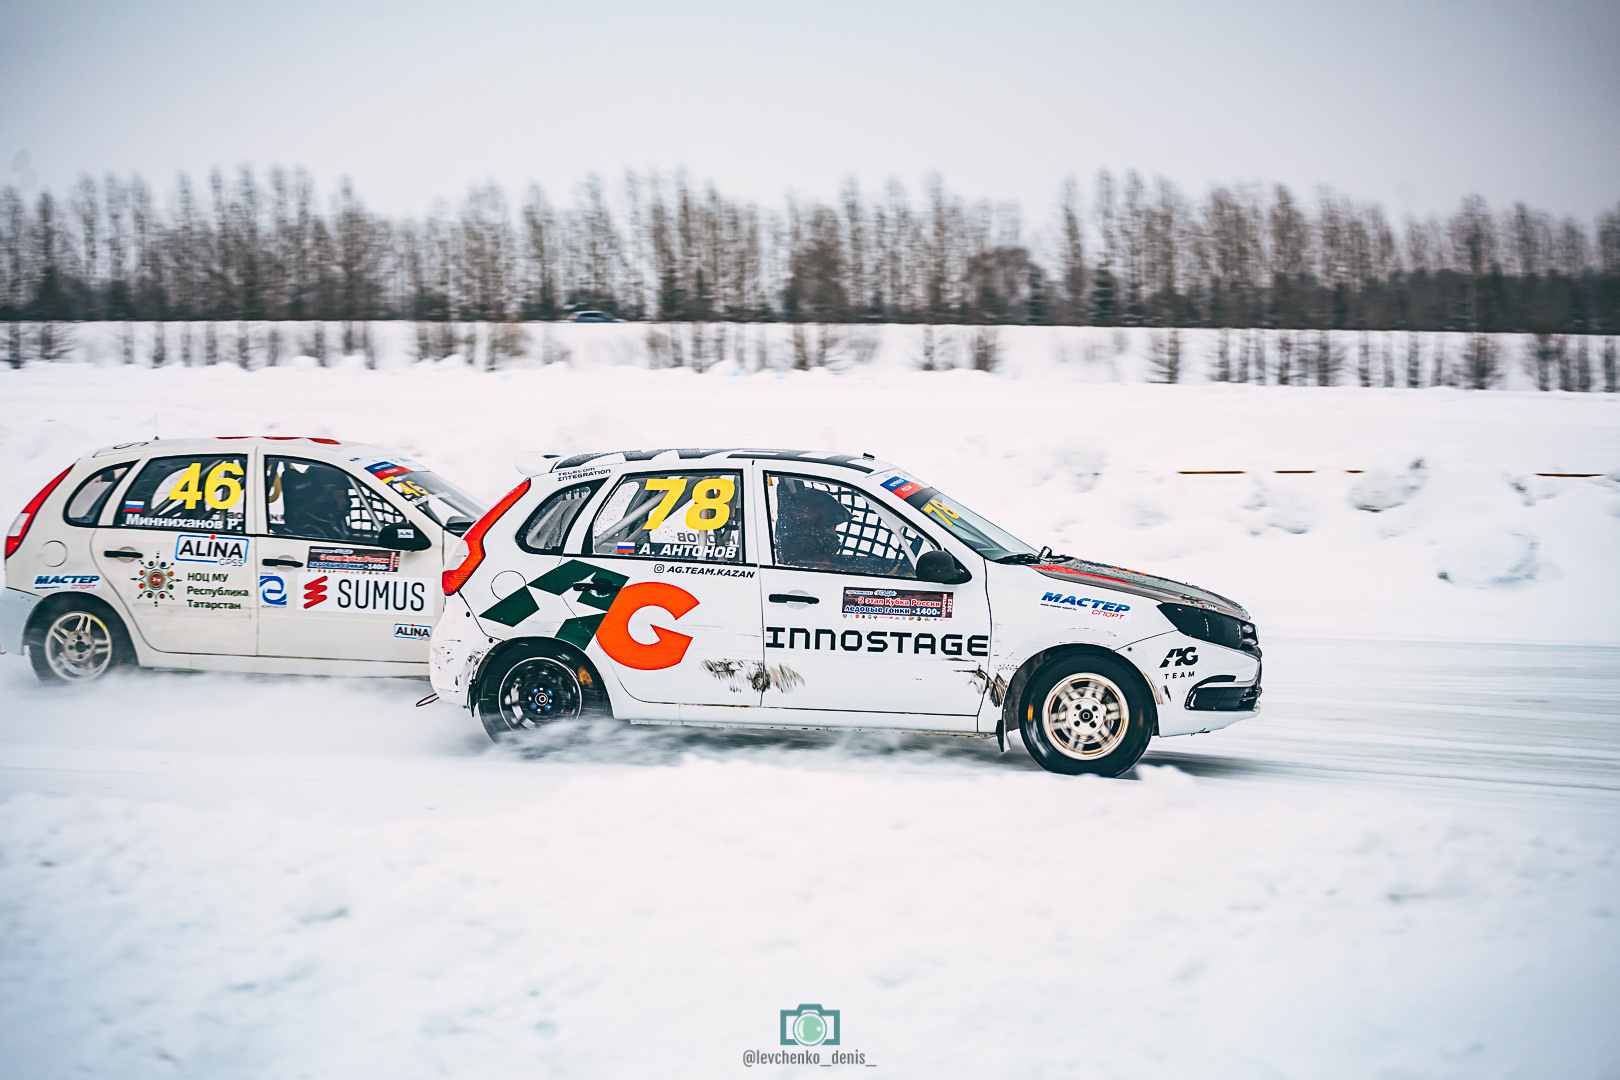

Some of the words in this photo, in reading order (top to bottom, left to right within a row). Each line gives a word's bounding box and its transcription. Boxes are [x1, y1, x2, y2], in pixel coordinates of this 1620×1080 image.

[558, 468, 611, 482] INTEGRATION
[169, 462, 244, 510] 46
[641, 478, 735, 531] 78
[923, 499, 960, 527] 78
[125, 513, 224, 530] Минниханов
[227, 518, 242, 530] Р.
[178, 540, 243, 559] ALINA
[638, 542, 655, 555] А.
[660, 544, 737, 559] АНТОНОВ
[34, 575, 100, 584] МАСТЕР
[187, 572, 209, 583] НОЦ
[212, 573, 228, 582] МУ
[666, 565, 755, 579] AG.TEAM.KAZAN
[186, 586, 249, 597] Республика
[337, 579, 425, 611] SUMUS
[186, 599, 242, 610] Татарстан
[885, 598, 910, 607] Кубка
[911, 598, 940, 607] России
[1041, 591, 1131, 613] МАСТЕР
[395, 626, 430, 638] ALINA
[765, 626, 989, 657] INNOSTAGE
[1164, 671, 1195, 680] TEAM
